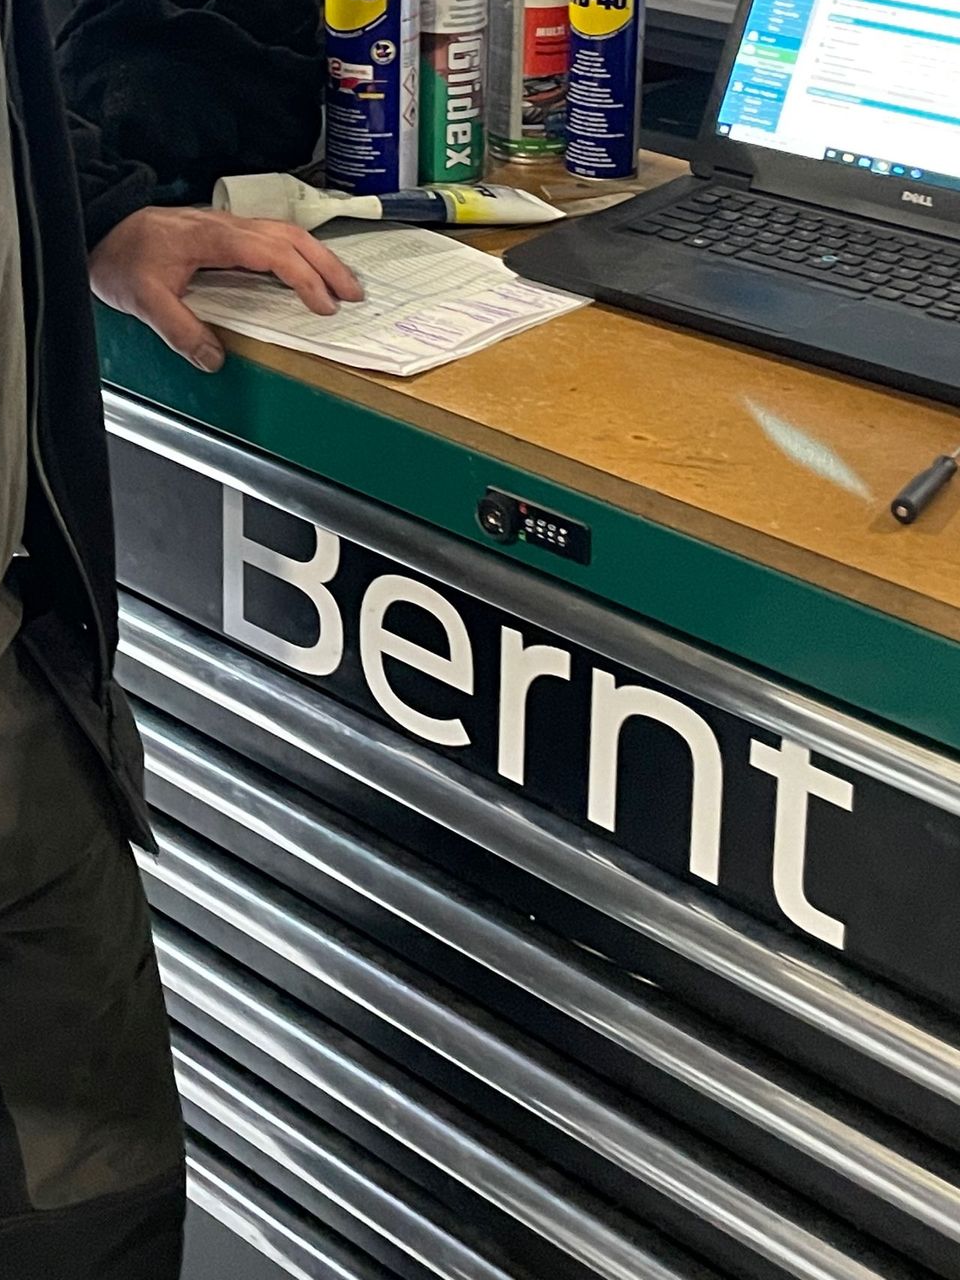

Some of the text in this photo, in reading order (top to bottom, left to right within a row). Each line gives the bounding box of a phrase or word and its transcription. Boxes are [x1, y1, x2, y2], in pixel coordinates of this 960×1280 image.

[446, 40, 481, 169] Glidex
[901, 191, 933, 207] DELL
[222, 483, 853, 950] Bernt
